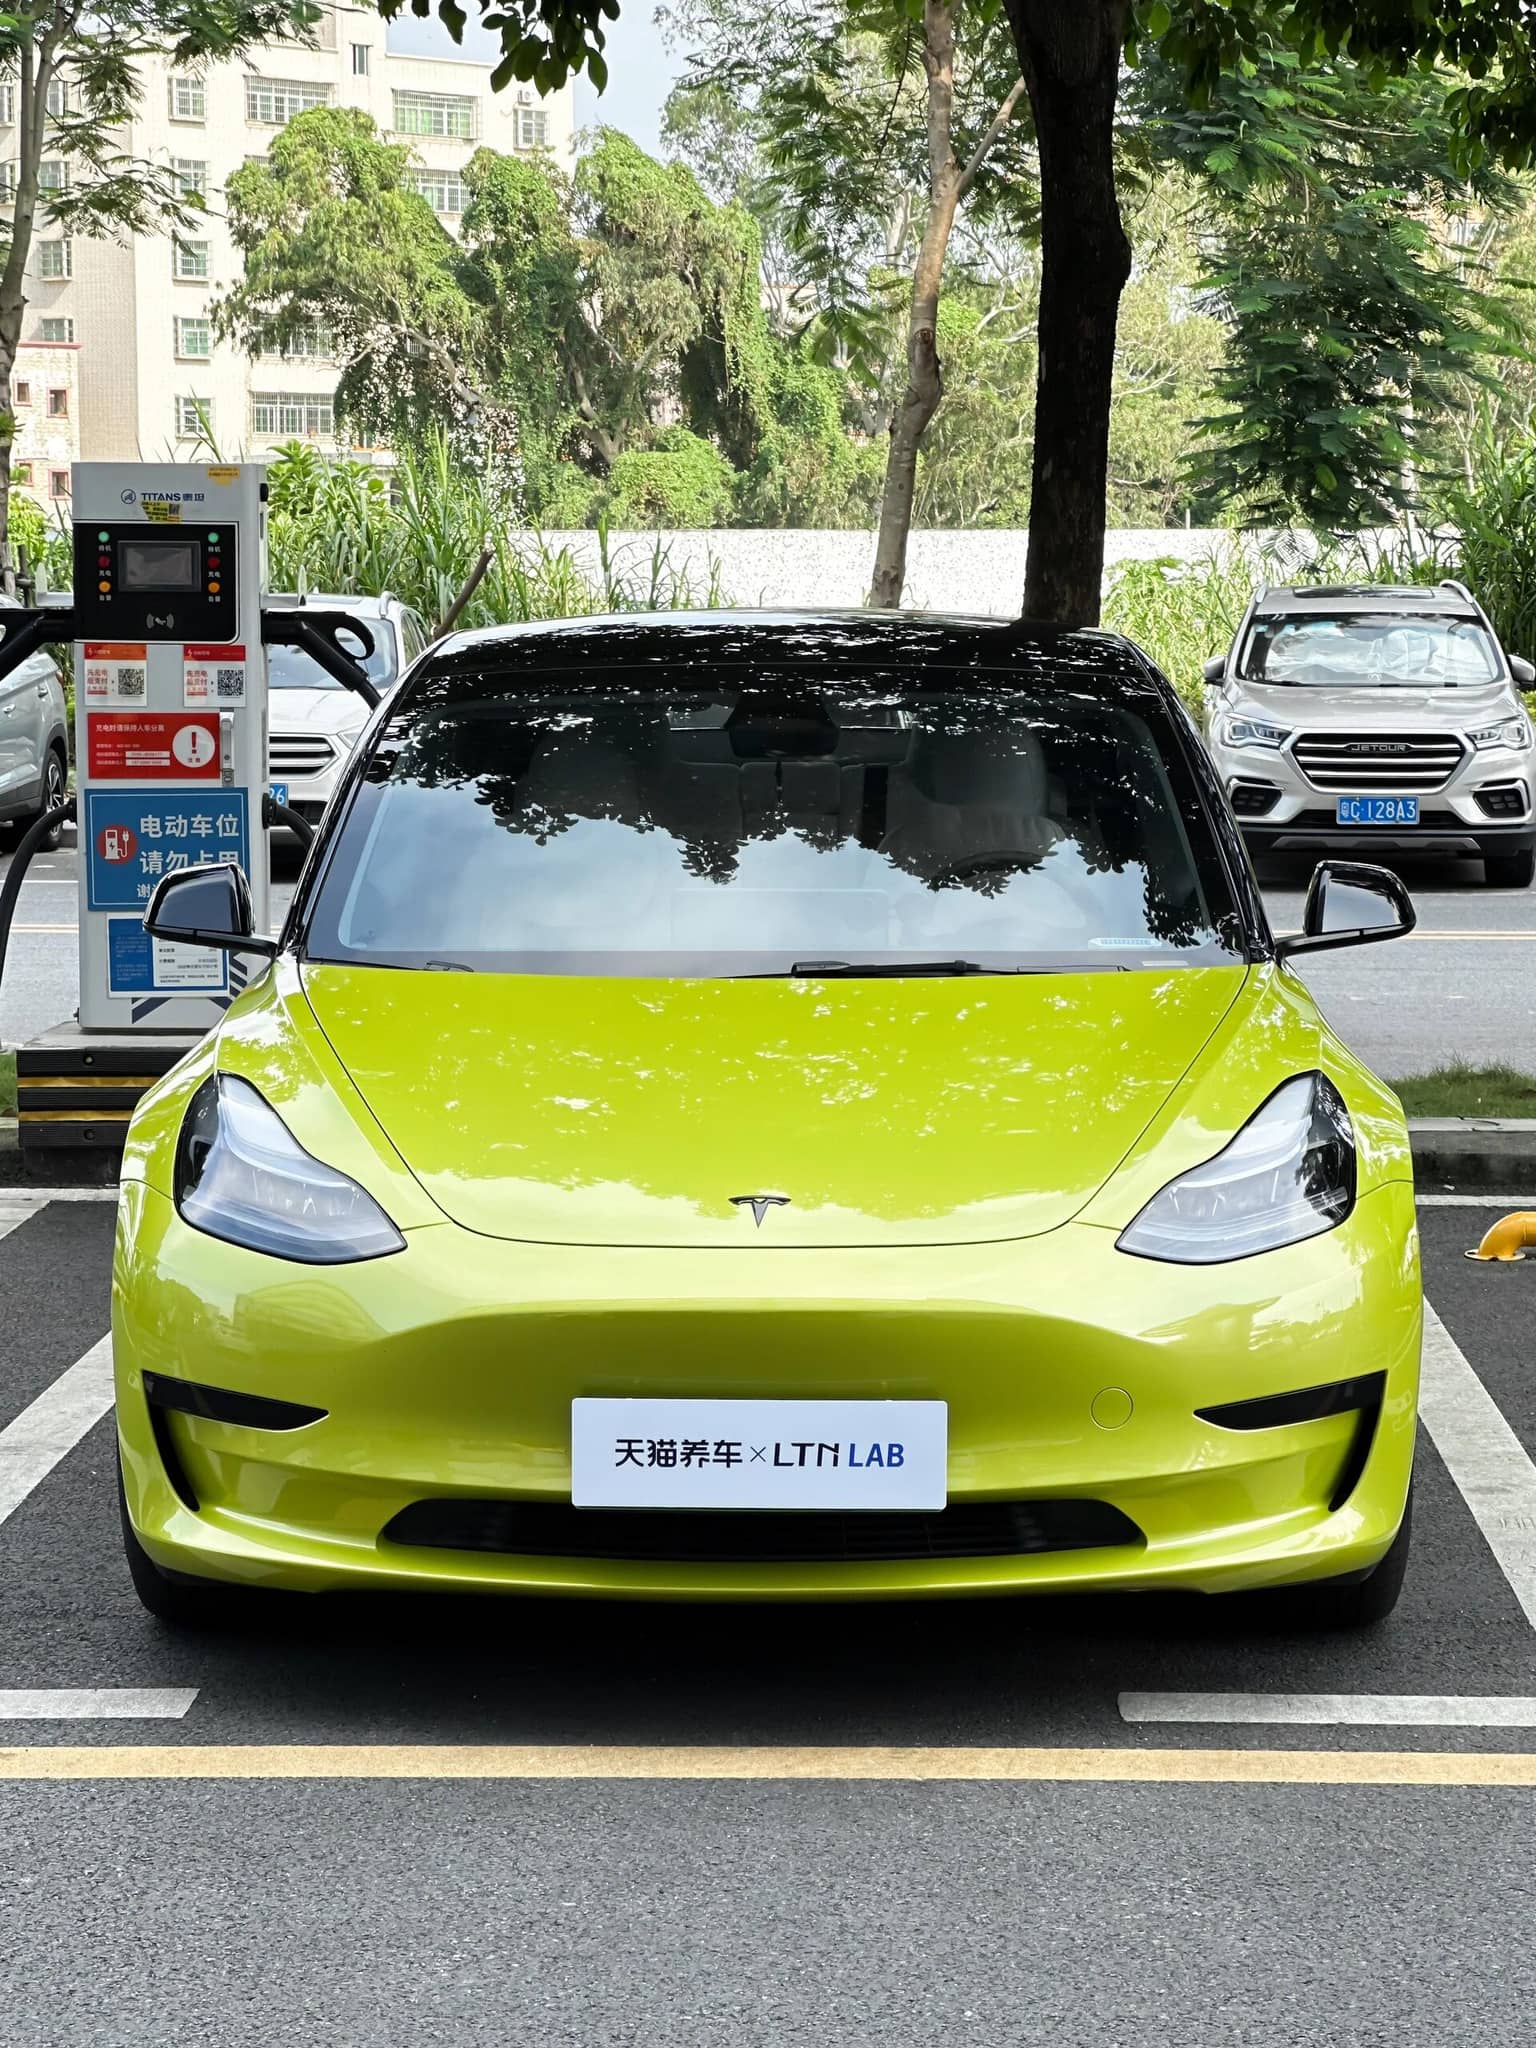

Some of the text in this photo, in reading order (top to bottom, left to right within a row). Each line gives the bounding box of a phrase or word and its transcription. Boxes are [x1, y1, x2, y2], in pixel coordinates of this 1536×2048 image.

[141, 492, 181, 502] TITANS
[1351, 744, 1406, 752] JETOUR
[140, 813, 240, 838] 电动车位
[615, 1438, 743, 1468] 天猫养车
[773, 1442, 840, 1468] LTN
[847, 1443, 905, 1468] LAB
